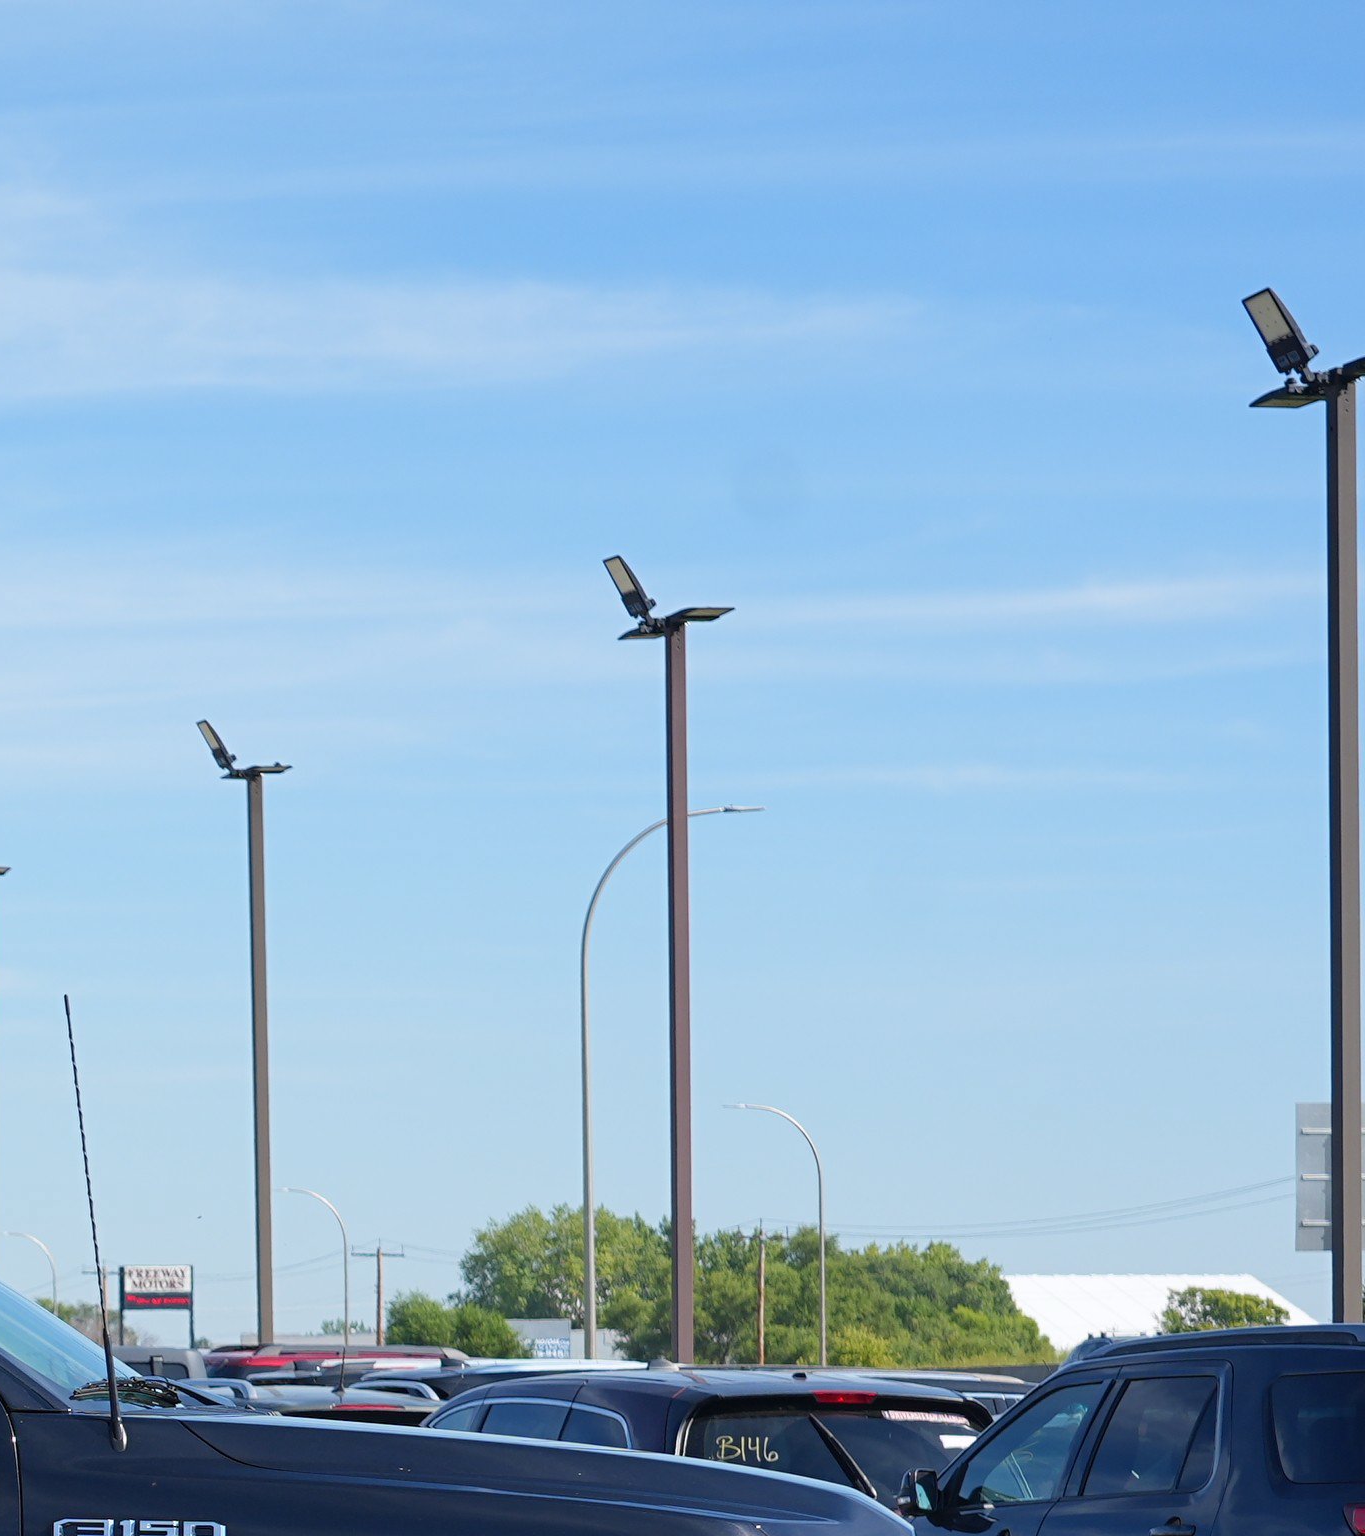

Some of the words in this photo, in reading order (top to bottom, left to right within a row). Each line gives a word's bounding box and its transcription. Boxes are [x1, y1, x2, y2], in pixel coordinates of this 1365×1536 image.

[127, 1266, 187, 1278] FREEWAY
[131, 1278, 185, 1289] MOTORS
[715, 1434, 780, 1463] B146
